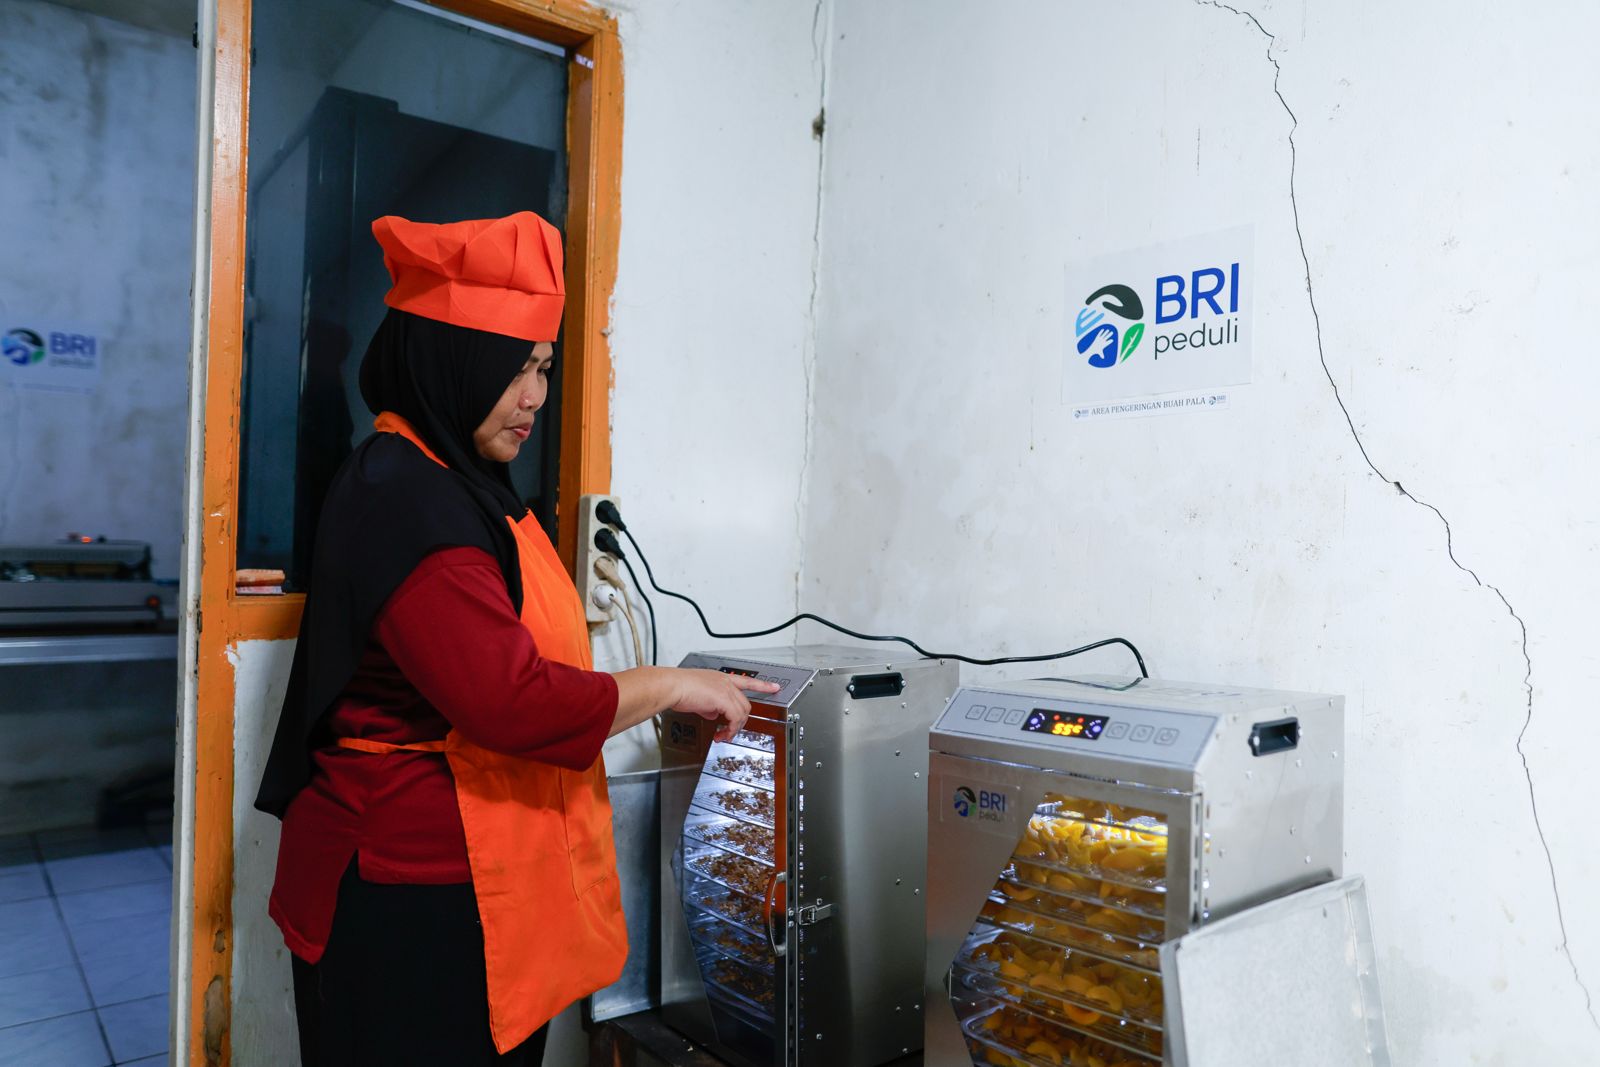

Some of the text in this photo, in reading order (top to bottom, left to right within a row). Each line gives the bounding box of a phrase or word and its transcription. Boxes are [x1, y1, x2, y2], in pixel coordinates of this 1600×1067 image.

[1155, 262, 1240, 325] BRI
[48, 331, 97, 358] BRI
[1154, 317, 1238, 361] peduli
[1091, 407, 1110, 416] AREA
[1111, 402, 1162, 414] PENGERINGAN
[1163, 399, 1184, 409] BUAH
[1185, 396, 1206, 406] PALA
[979, 790, 1006, 813] BRI
